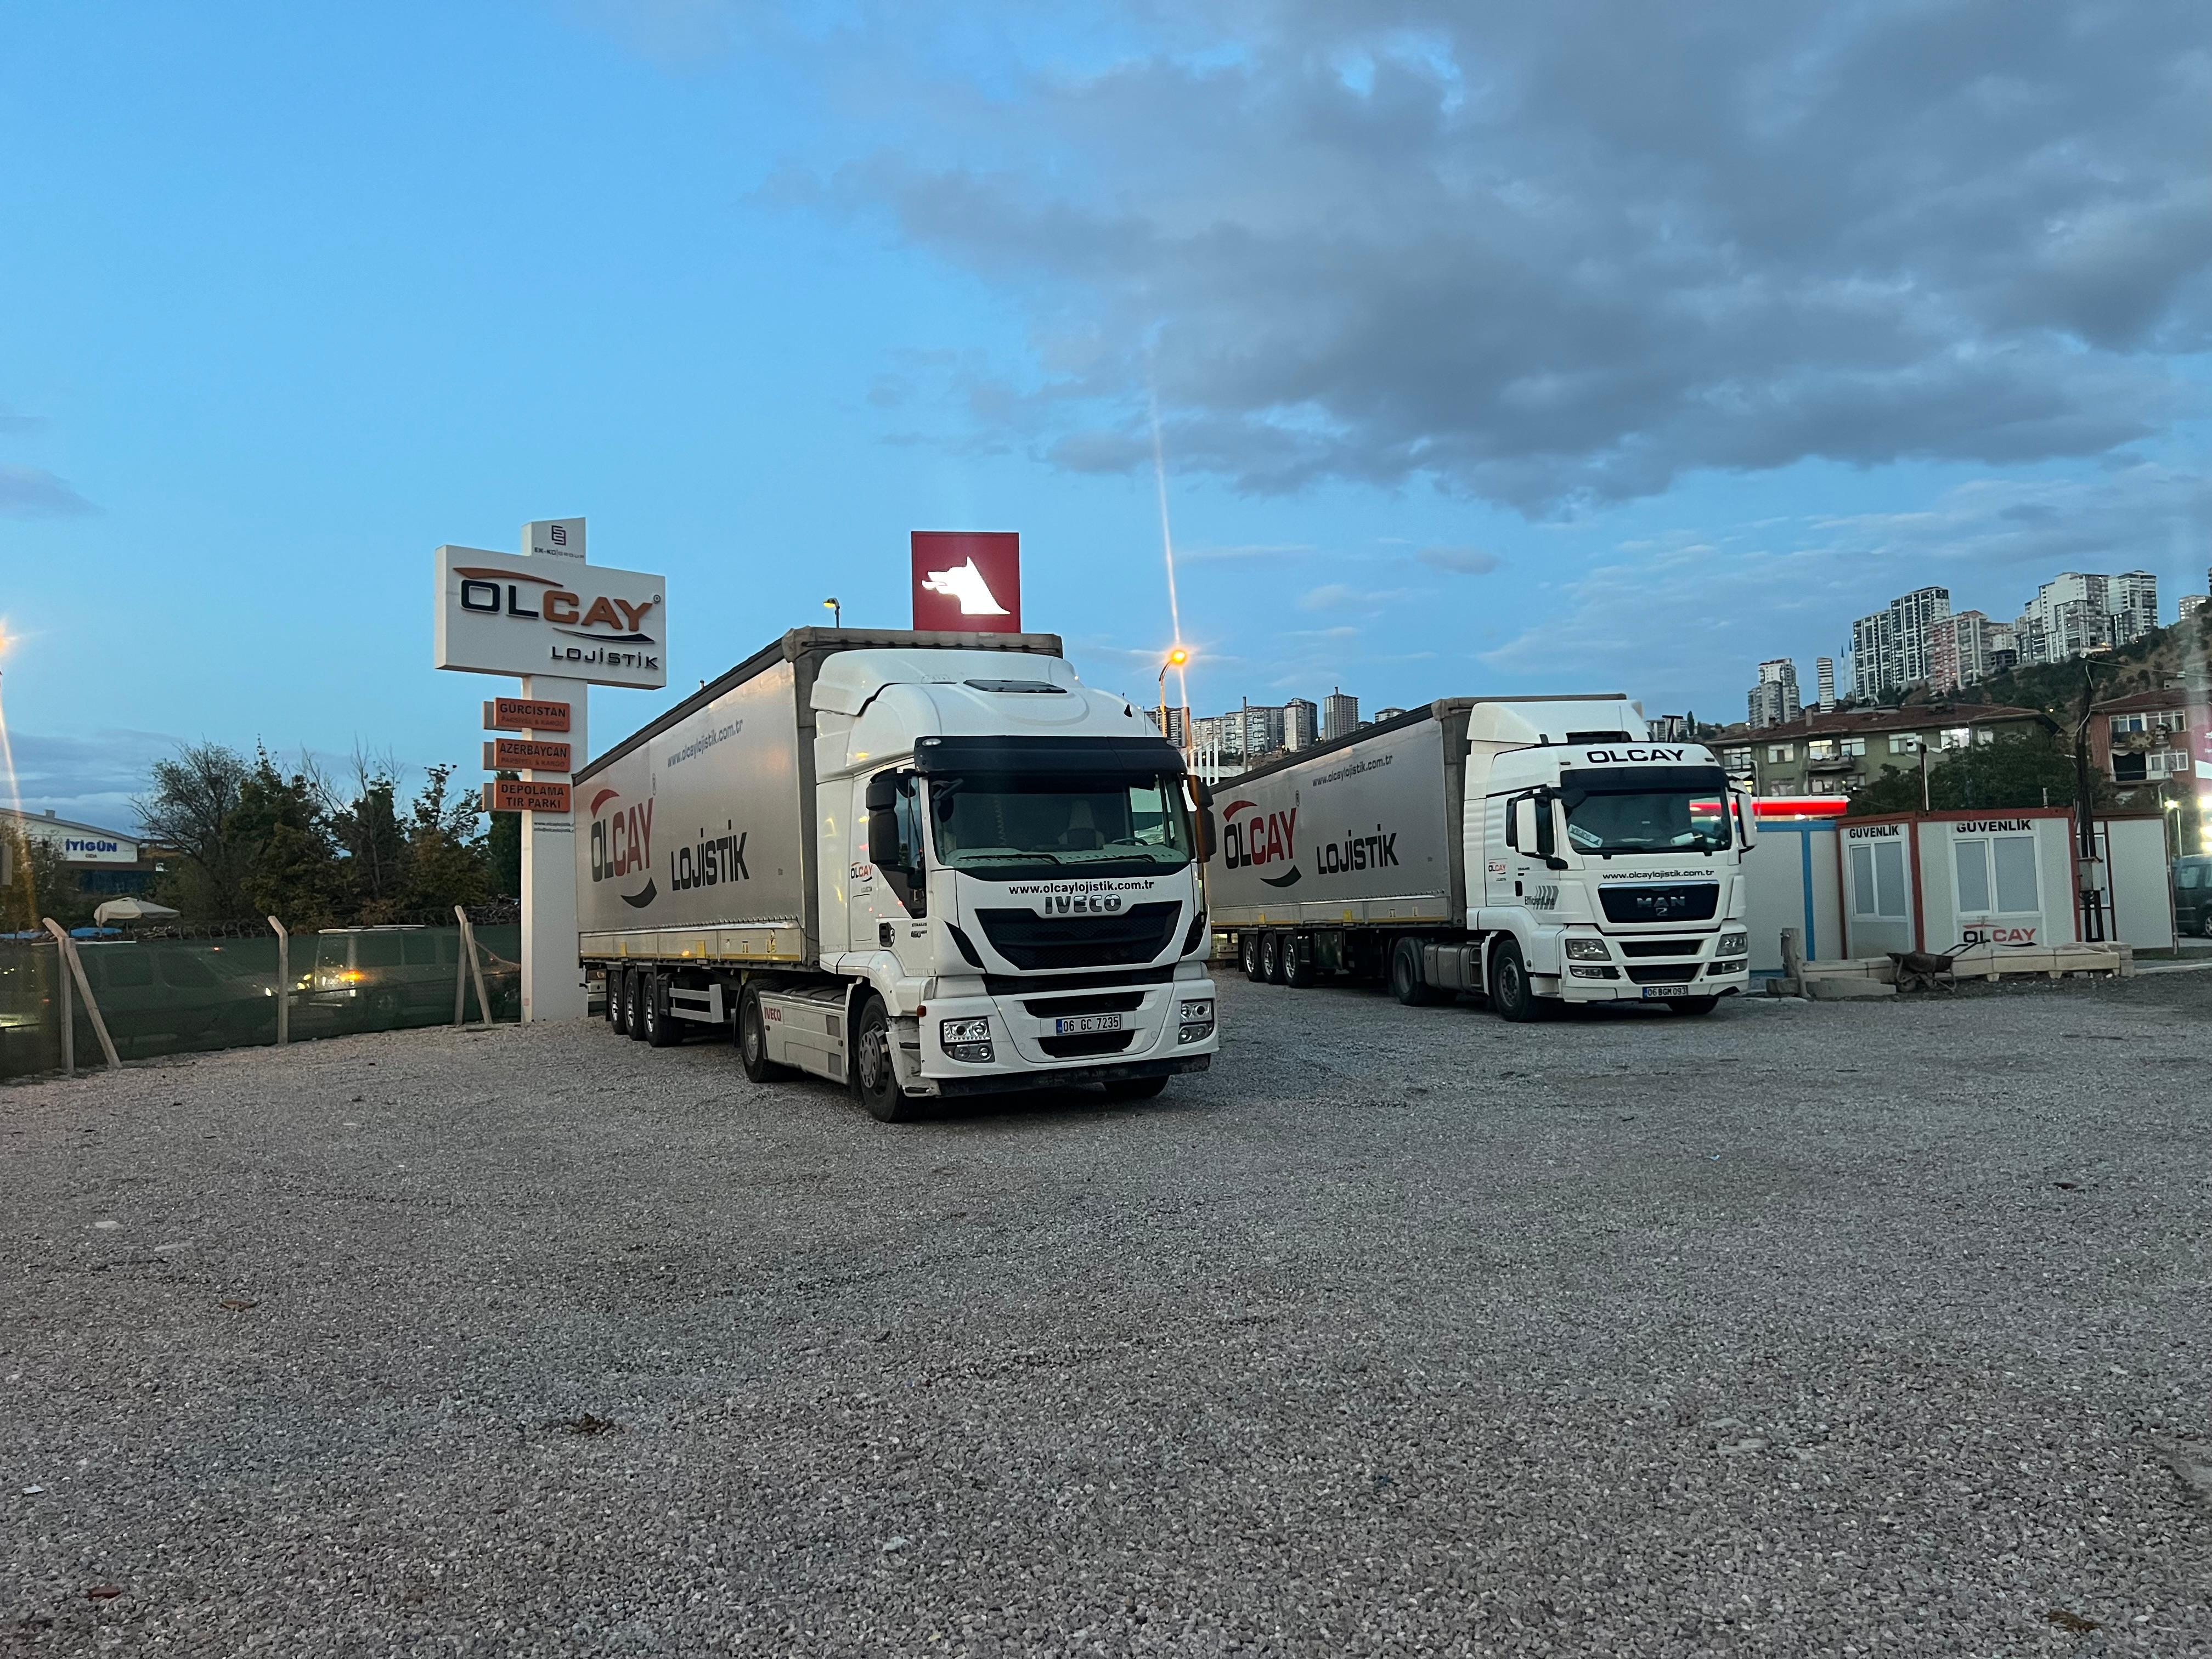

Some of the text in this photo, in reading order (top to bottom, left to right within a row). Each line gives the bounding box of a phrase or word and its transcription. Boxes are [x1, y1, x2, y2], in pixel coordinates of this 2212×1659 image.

[461, 579, 653, 631] OLCAY
[551, 646, 659, 669] LOJİSTİK
[500, 743, 567, 758] AZERBAYCAN
[668, 719, 743, 768] www.olcaylojistik.com.tr
[1587, 749, 1684, 763] OLCAY
[1312, 754, 1393, 787] www.olcaylojistik.com.tr
[501, 784, 564, 795] DEPOLAMA
[506, 797, 560, 808] TIR PARKI
[1957, 819, 2032, 833] GÜVENLİK
[66, 838, 117, 852] İYİGÜN
[591, 797, 653, 882] OLCAY
[1224, 808, 1296, 869] OLCAY
[671, 819, 749, 891] LOJİSTİK
[1317, 823, 1399, 874] LOJİSTİK
[851, 865, 873, 879] OLCAY
[1602, 870, 1714, 879] www.olcaylojistik.com.tr
[1008, 880, 1154, 894] www.olcaylojistik.com.tr
[1045, 894, 1121, 914] IVECO
[1637, 896, 1685, 908] MAN
[1963, 928, 2036, 943] OLCAY
[1648, 988, 1657, 996] 06
[1673, 986, 1686, 995] 093
[764, 1007, 781, 1022] IVECO
[1063, 1020, 1075, 1031] 06
[1081, 1019, 1092, 1030] GC
[1096, 1016, 1119, 1029] 7235
